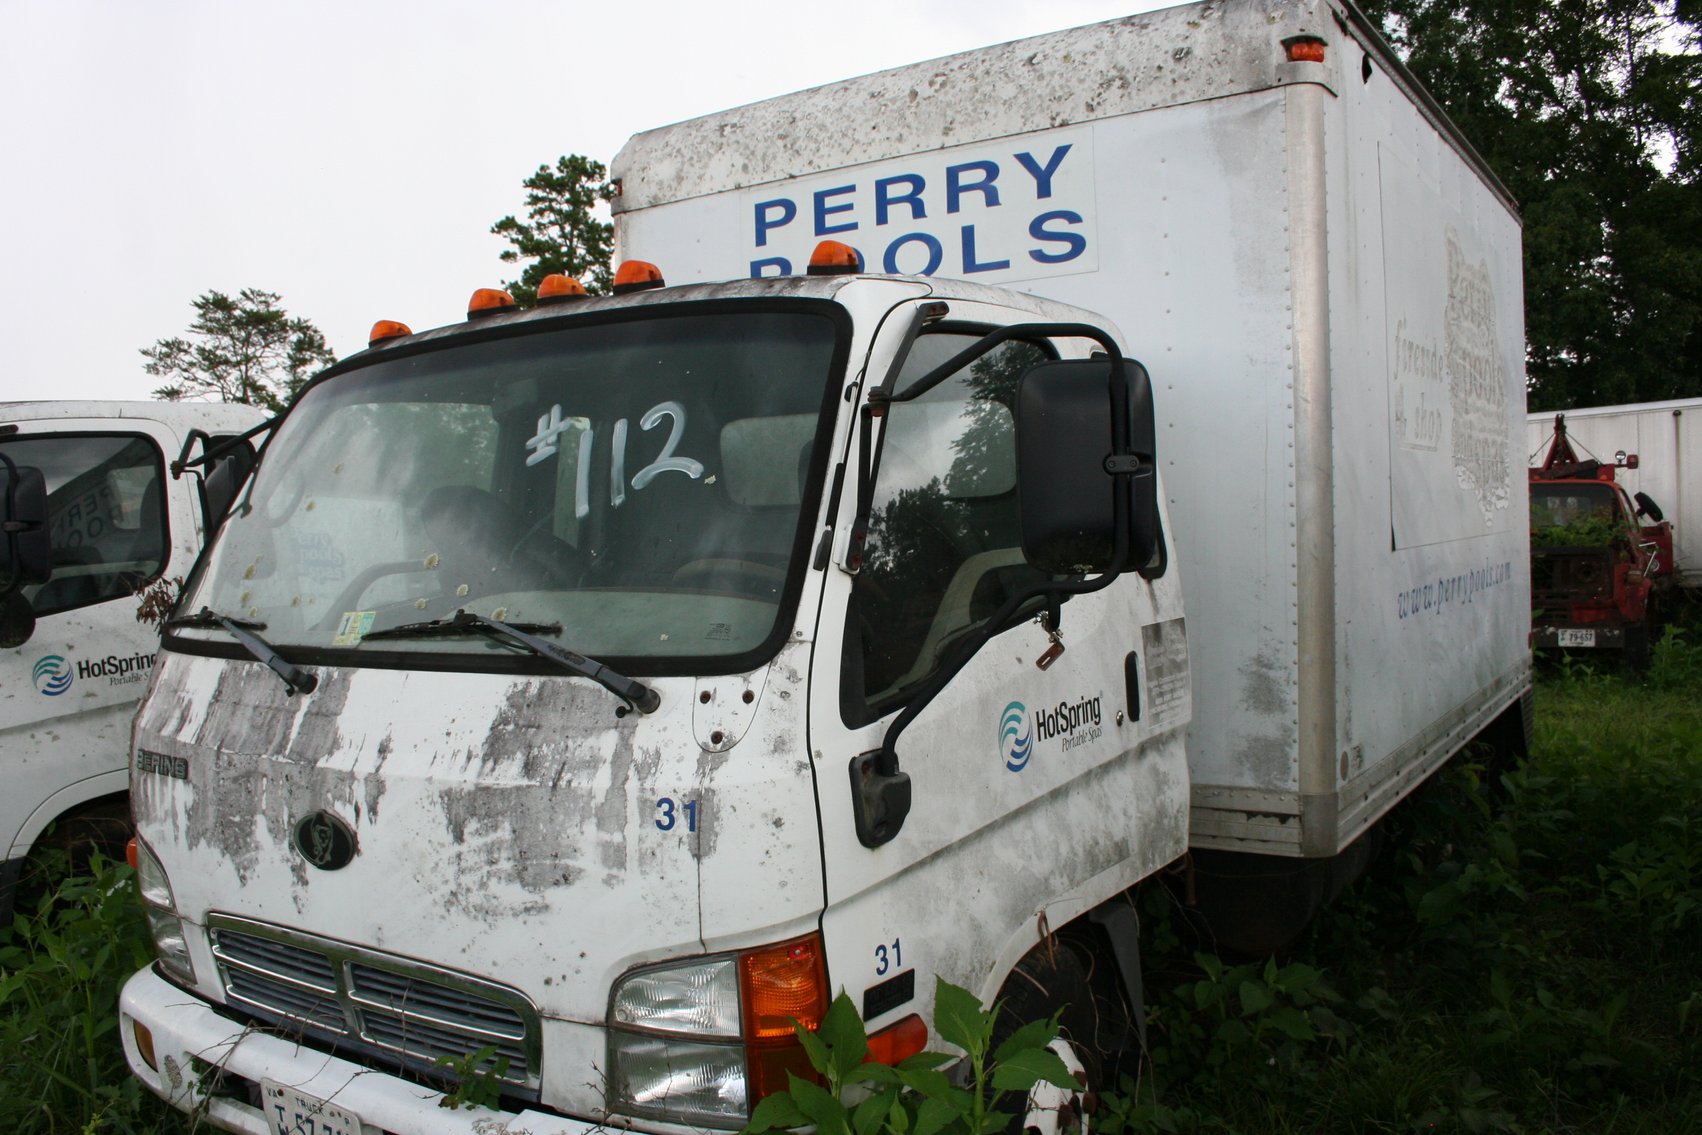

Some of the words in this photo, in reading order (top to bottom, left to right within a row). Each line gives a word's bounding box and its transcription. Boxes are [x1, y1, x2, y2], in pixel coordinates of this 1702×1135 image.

[754, 144, 1074, 247] PERRY
[750, 210, 1087, 279] POLS
[1397, 557, 1511, 620] www.perrypools.com
[1036, 696, 1101, 742] HotSpring
[1061, 729, 1088, 753] Portable
[1088, 726, 1102, 744] Spas
[655, 797, 698, 832] 31
[875, 937, 902, 976] 31
